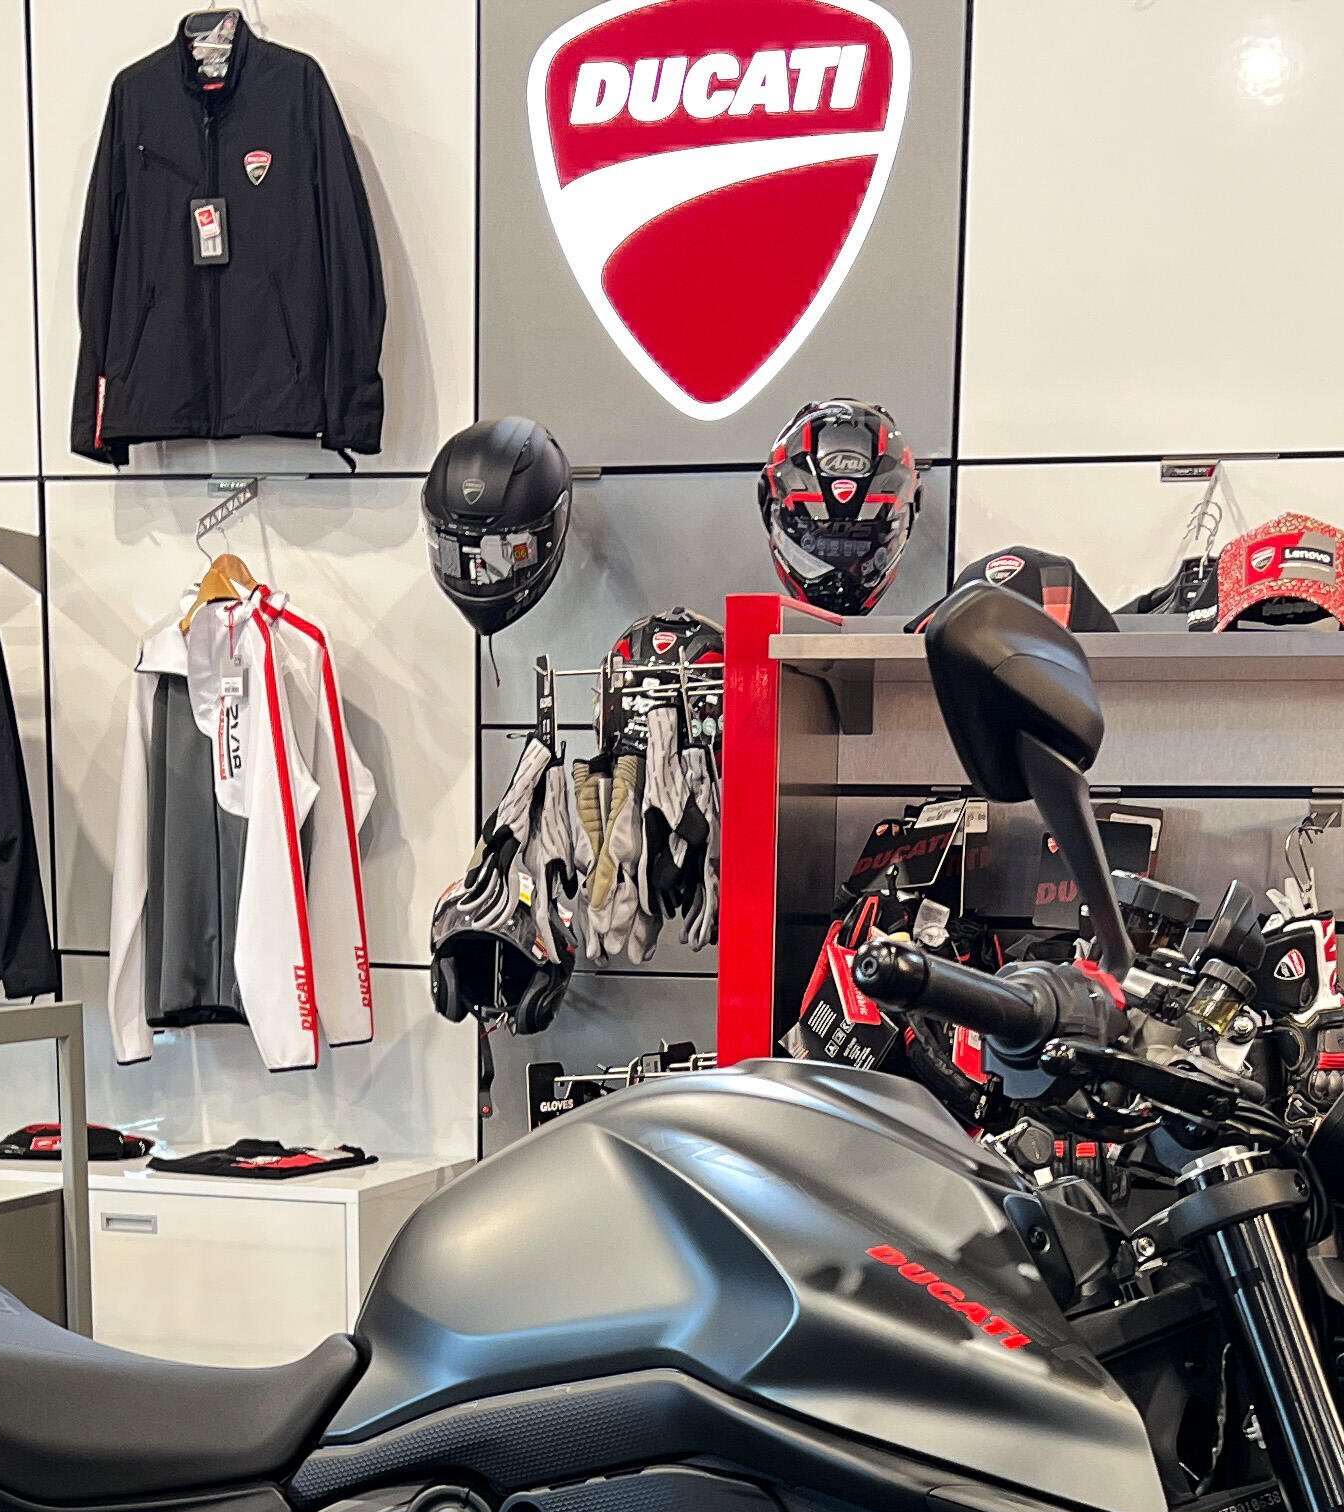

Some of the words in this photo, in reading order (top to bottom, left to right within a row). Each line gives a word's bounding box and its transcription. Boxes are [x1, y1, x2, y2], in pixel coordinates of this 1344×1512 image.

[570, 44, 867, 126] DUCATI
[830, 454, 864, 469] Arai
[1284, 548, 1331, 563] Lenovo
[851, 831, 953, 877] DUCATI
[293, 964, 314, 1031] DUCATI
[539, 1098, 574, 1113] GLOVES
[865, 1244, 1032, 1350] DUCATI
